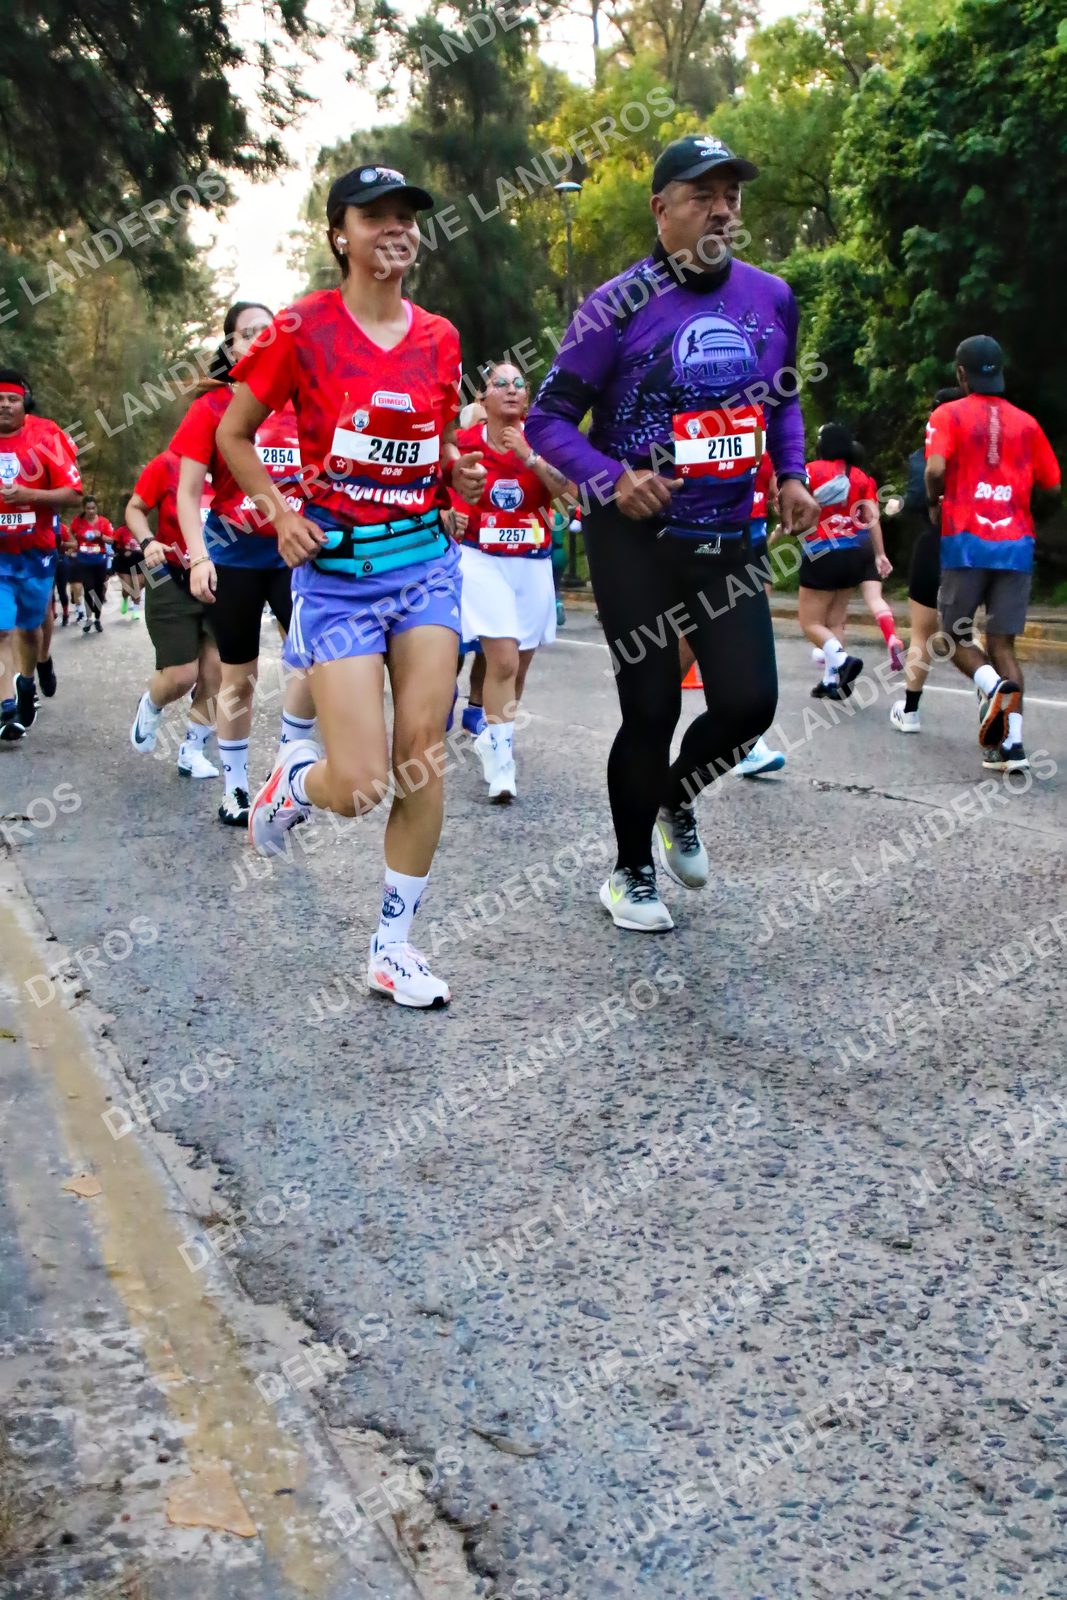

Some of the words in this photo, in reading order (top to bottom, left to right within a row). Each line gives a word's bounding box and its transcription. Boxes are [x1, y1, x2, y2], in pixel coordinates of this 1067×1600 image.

[682, 358, 755, 381] MRT
[263, 448, 294, 463] 2854
[368, 438, 421, 464] 2463
[708, 437, 742, 459] 2716
[1, 513, 23, 524] 2878
[499, 529, 526, 542] 2257
